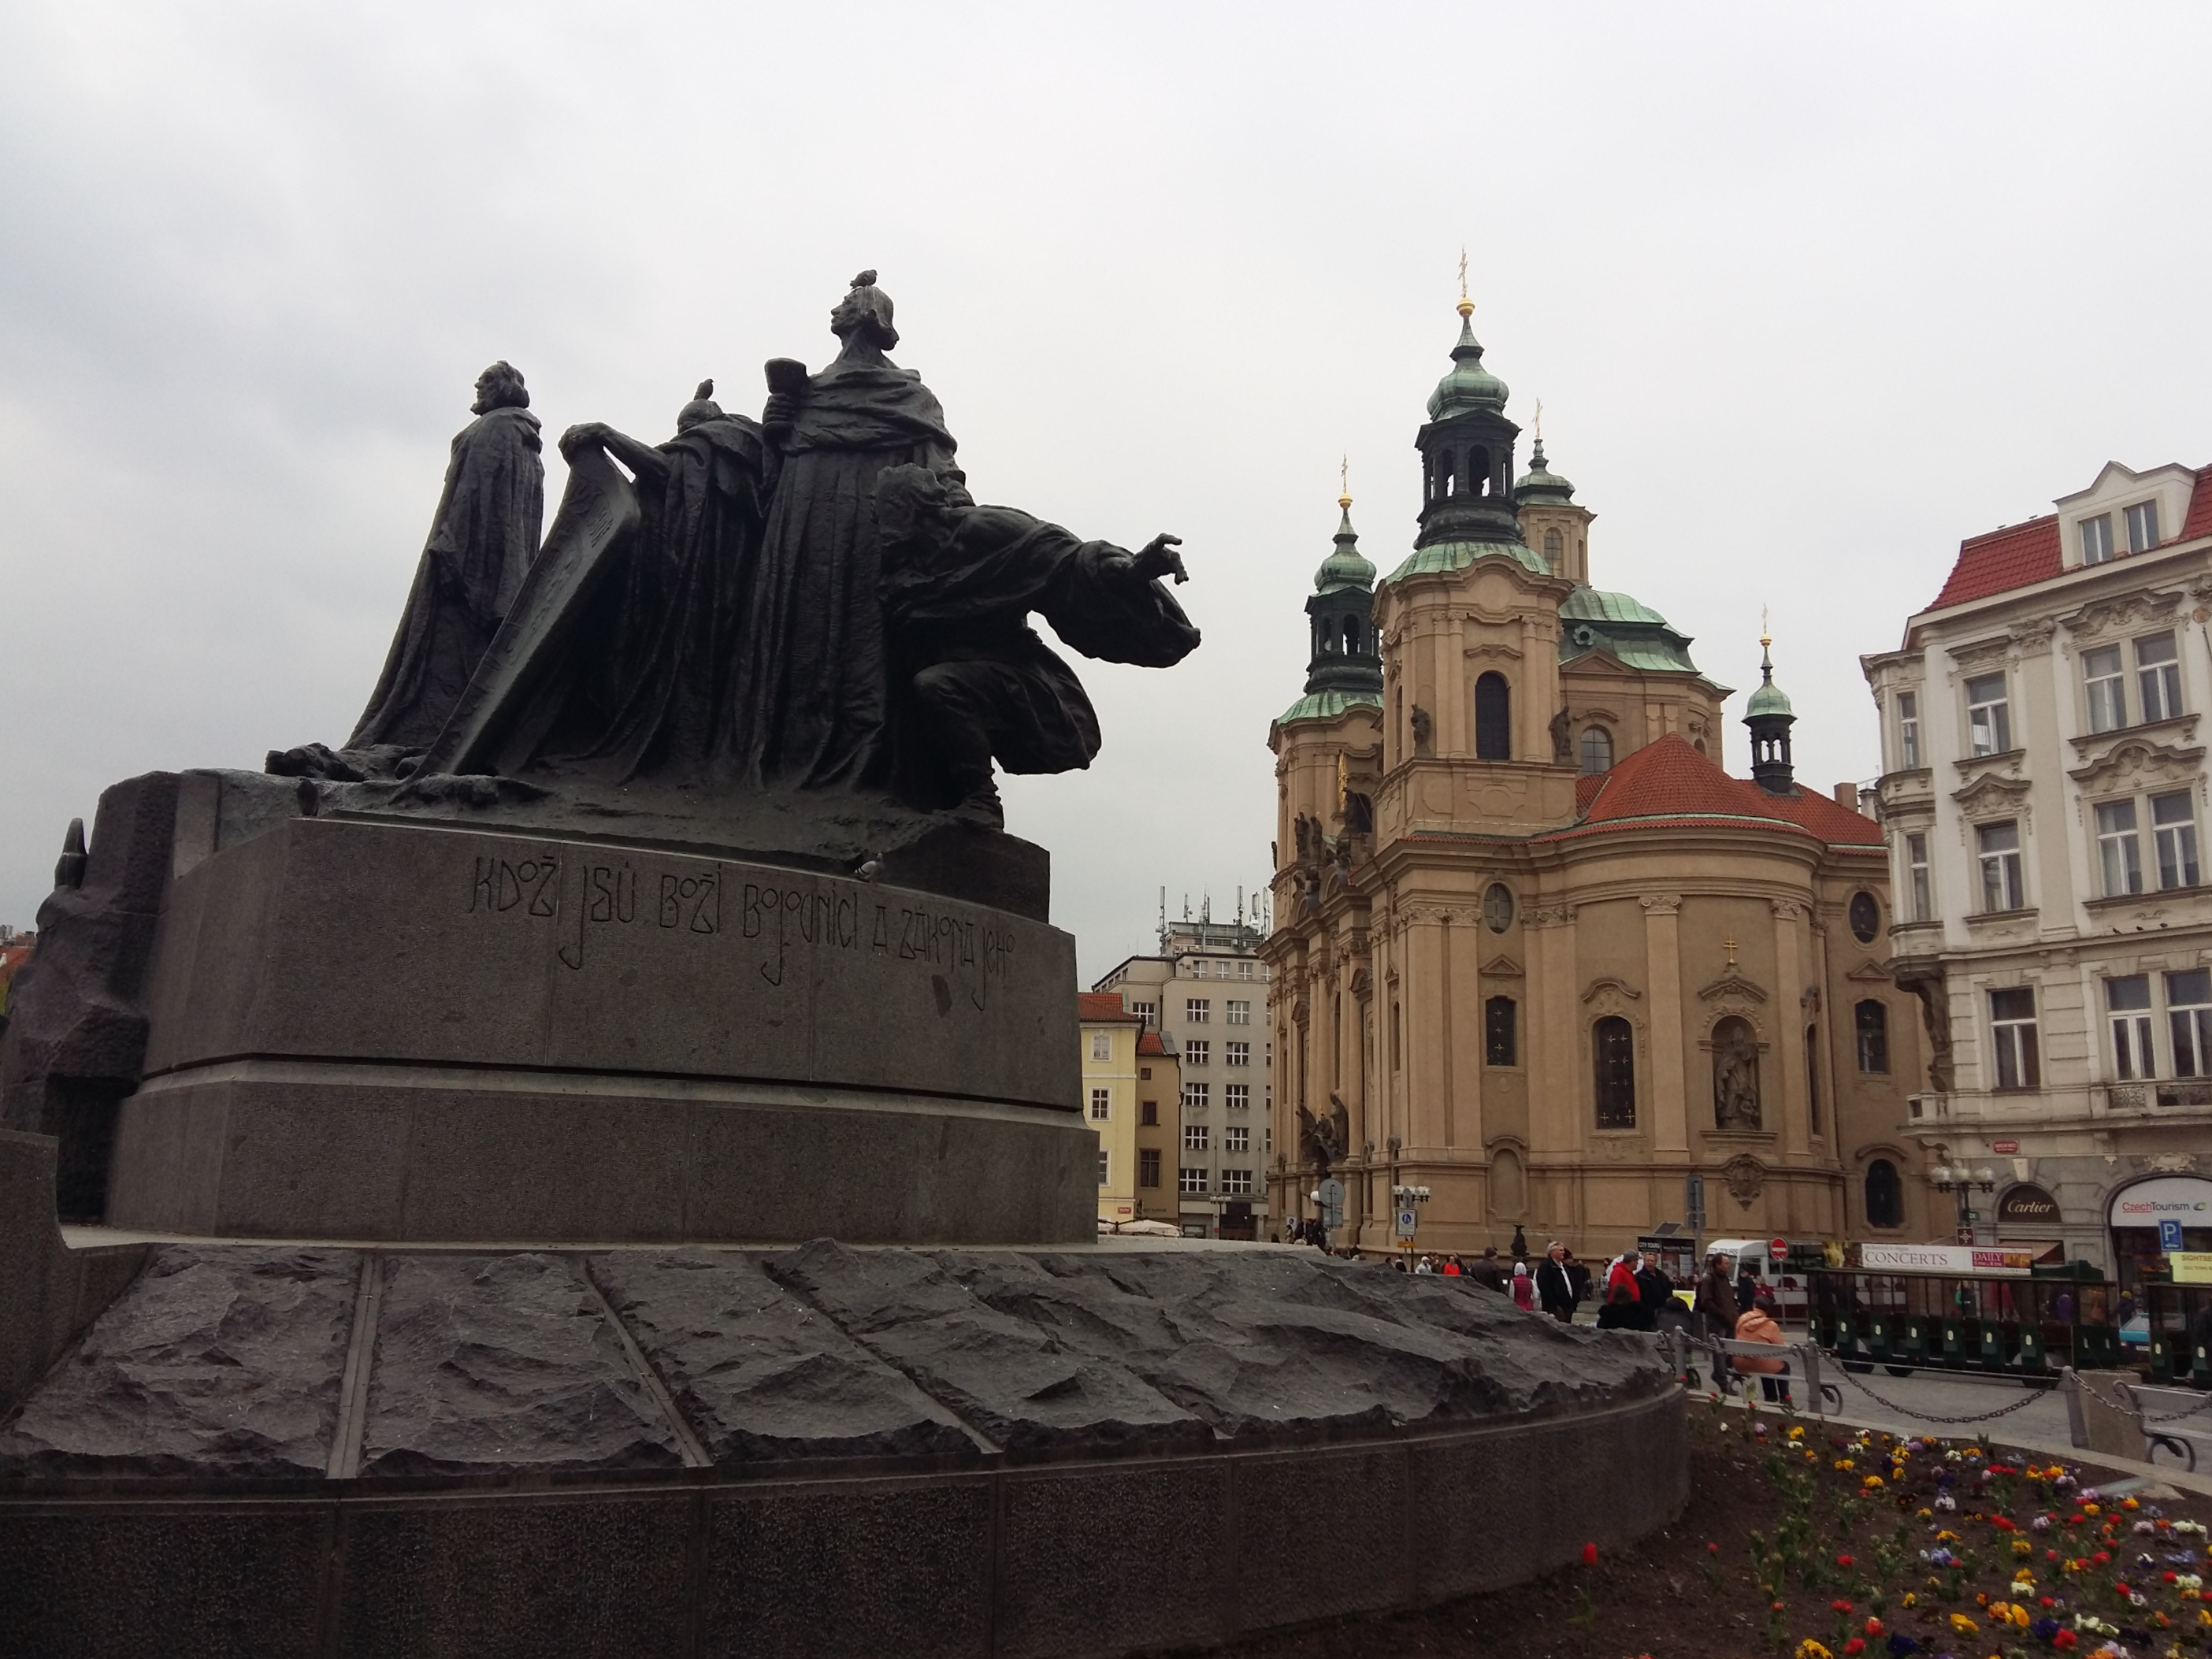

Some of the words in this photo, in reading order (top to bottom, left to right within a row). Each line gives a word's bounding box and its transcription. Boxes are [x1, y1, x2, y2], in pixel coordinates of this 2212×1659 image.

[871, 905, 889, 955] A
[2007, 1199, 2054, 1213] Cartier
[2121, 1201, 2190, 1212] CzechTourism
[2163, 1223, 2177, 1241] P
[1865, 1251, 1949, 1266] CONCERTS
[1973, 1252, 2002, 1261] DAILY
